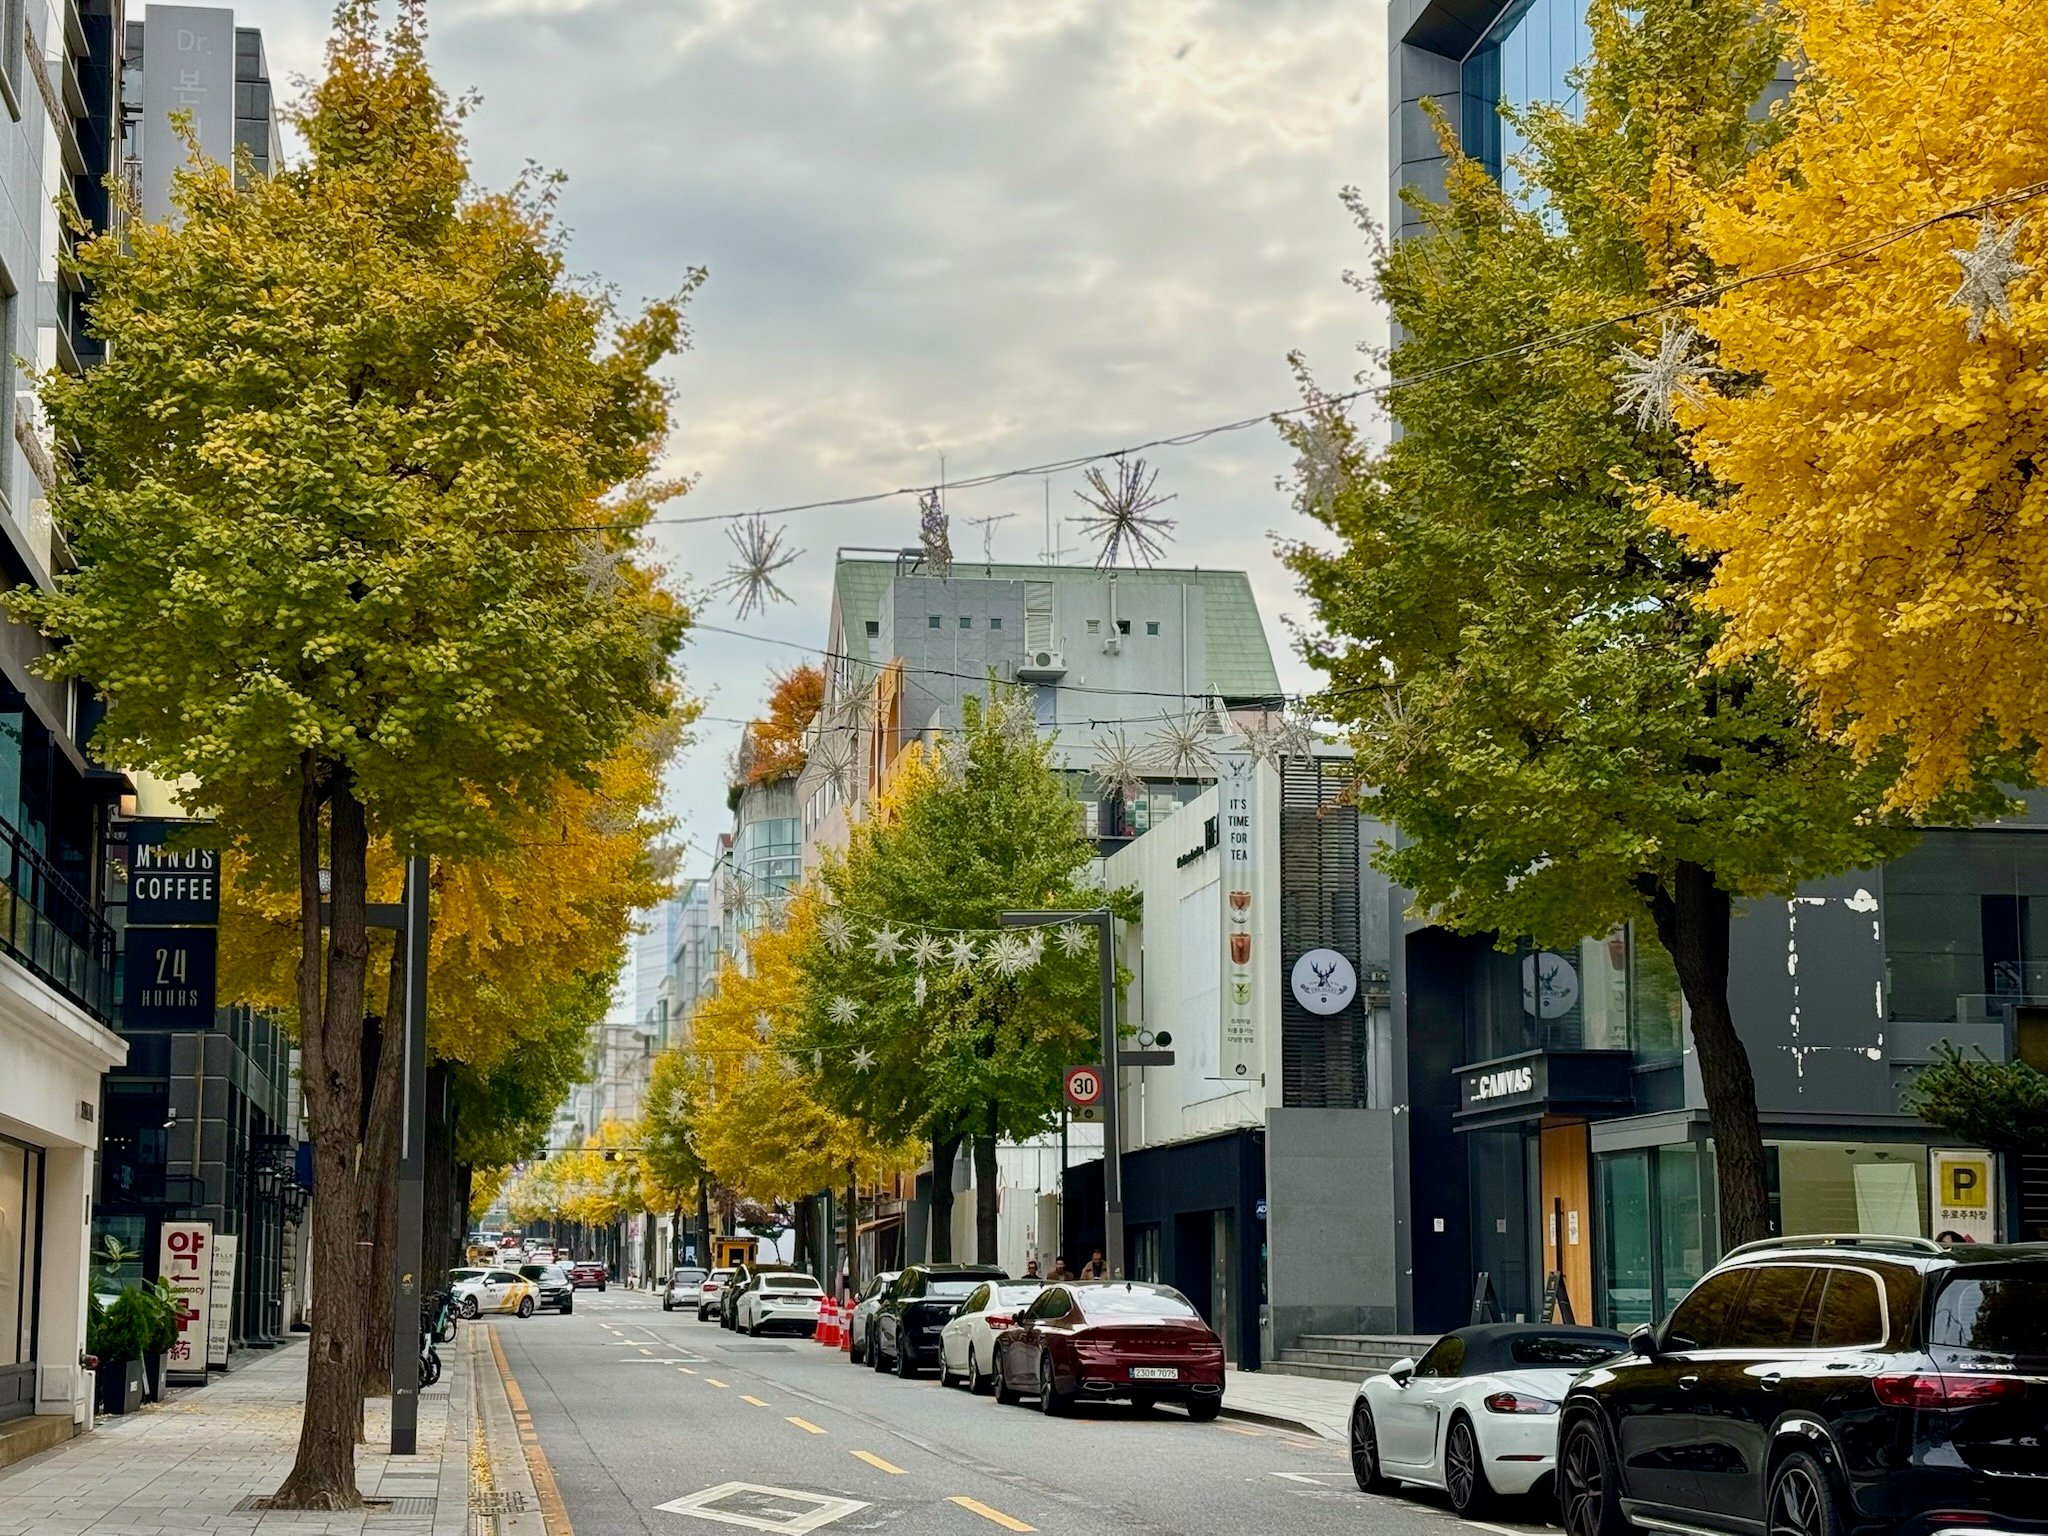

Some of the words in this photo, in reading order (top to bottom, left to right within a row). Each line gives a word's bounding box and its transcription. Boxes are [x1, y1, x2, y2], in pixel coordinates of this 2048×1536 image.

[1230, 798, 1247, 810] IT'S
[1228, 815, 1249, 827] TIME
[1230, 832, 1247, 844] FOR
[1230, 849, 1247, 861] TEA
[135, 877, 213, 901] COFFEE
[156, 948, 187, 985] 24
[141, 989, 199, 1007] HOURS
[1073, 1077, 1094, 1095] 30
[1480, 1066, 1532, 1099] CANVAS
[1953, 1168, 1978, 1201] P
[167, 1231, 205, 1271] 약
[1157, 1369, 1177, 1378] 7075
